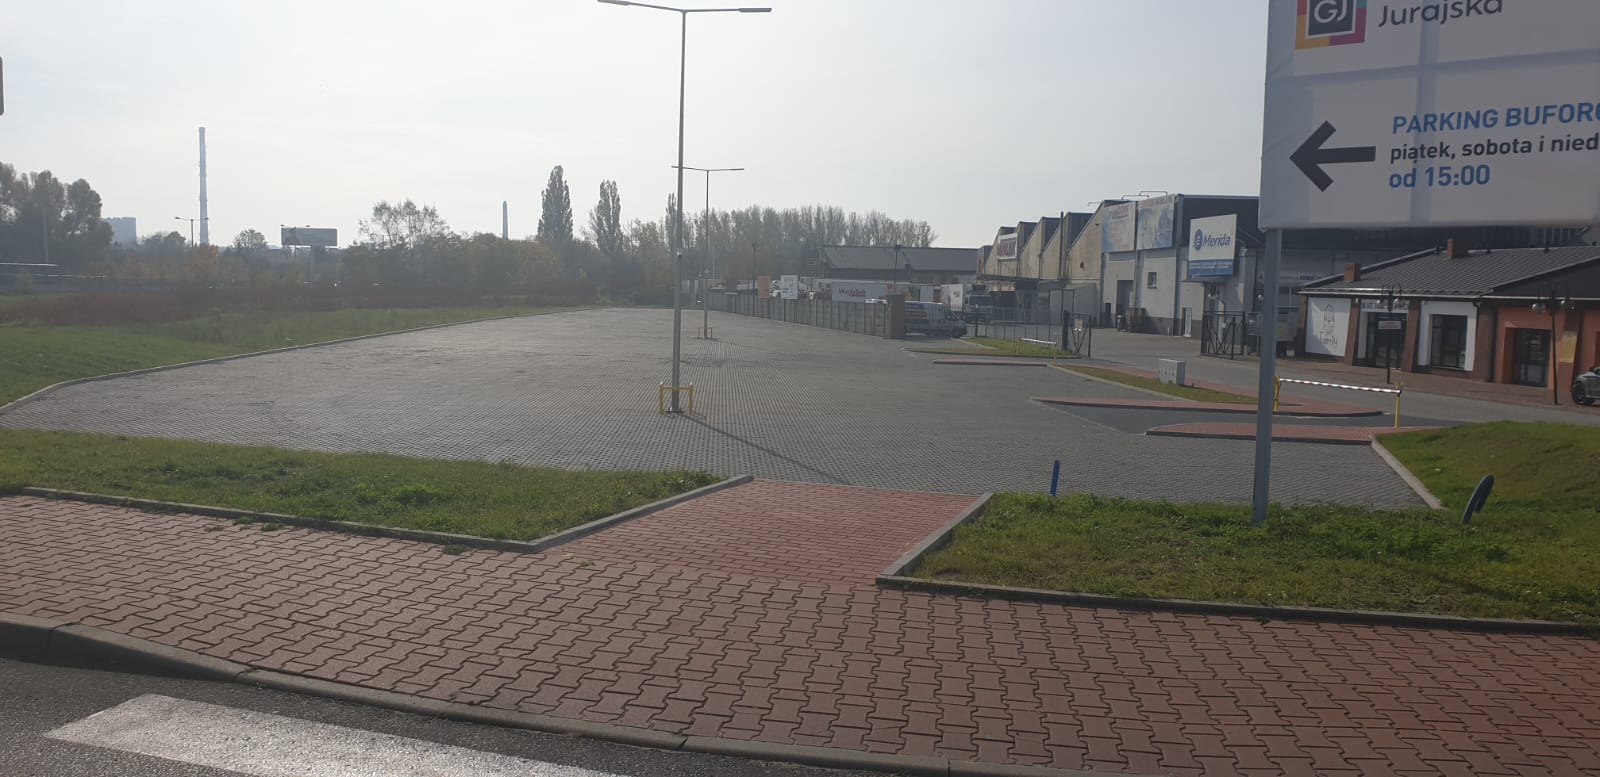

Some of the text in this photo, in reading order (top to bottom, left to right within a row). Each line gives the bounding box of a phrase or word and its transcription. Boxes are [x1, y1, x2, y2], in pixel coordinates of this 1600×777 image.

[1313, 0, 1348, 24] GJ
[1378, 0, 1503, 27] Jurajska
[1392, 109, 1498, 134] PARKING
[1390, 141, 1456, 165] piątek,
[1461, 138, 1532, 157] sobota
[1539, 136, 1545, 152] i
[1389, 164, 1490, 188] od 15:00
[1203, 233, 1231, 247] Merida
